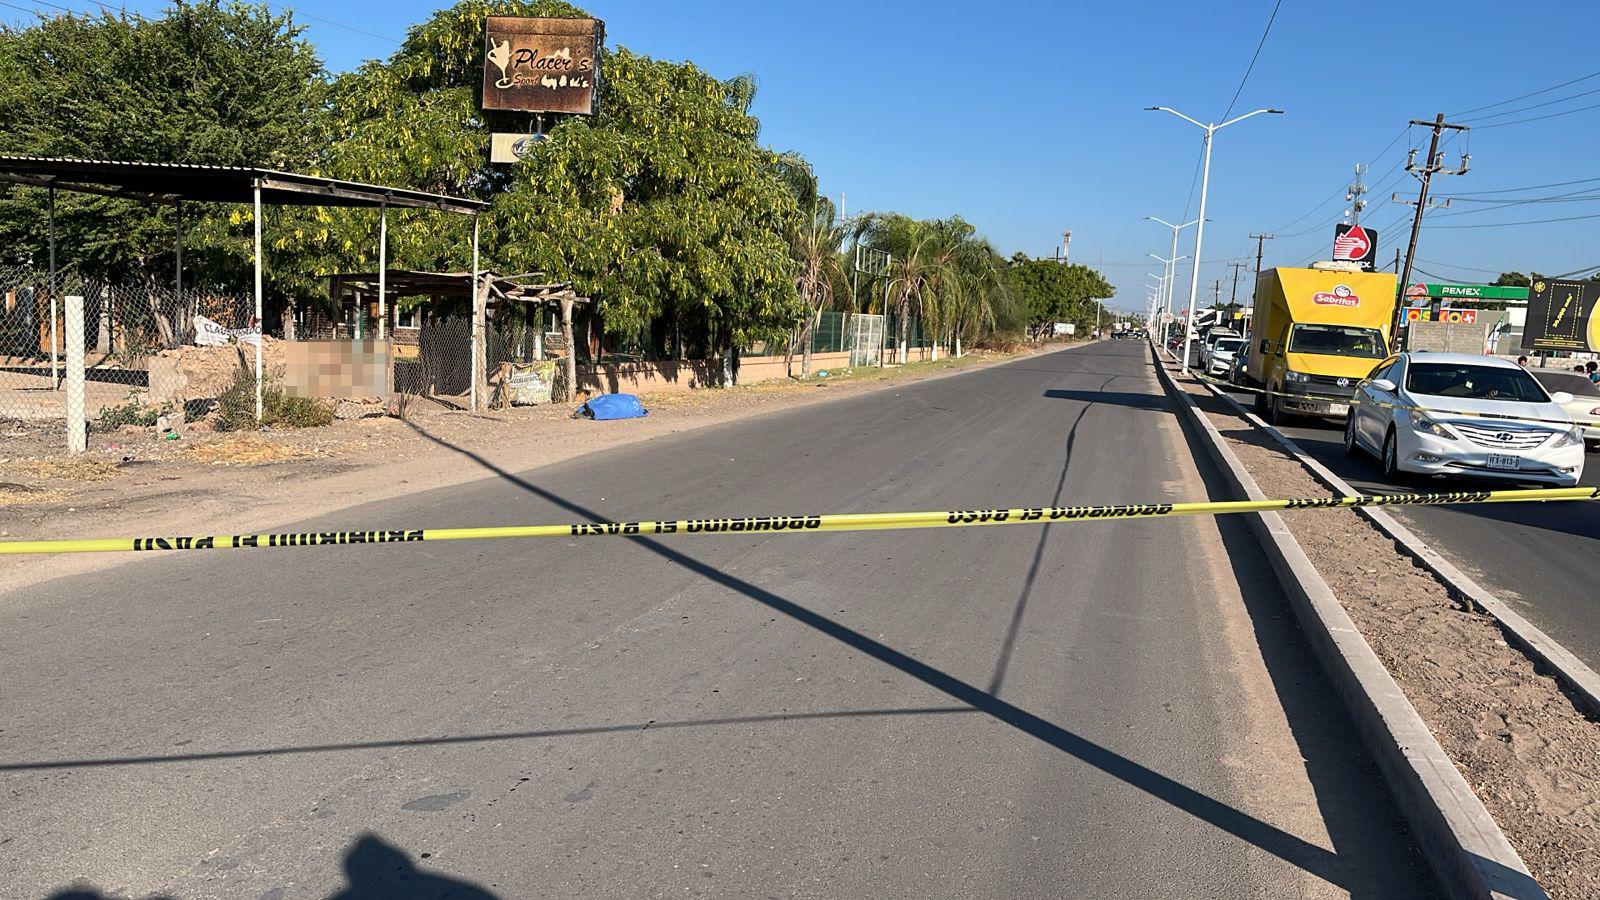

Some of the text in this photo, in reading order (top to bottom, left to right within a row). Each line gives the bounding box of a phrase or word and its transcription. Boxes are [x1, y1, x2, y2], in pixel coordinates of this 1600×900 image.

[1442, 286, 1480, 296] PEMEX
[1316, 294, 1356, 306] Sabritas
[204, 323, 262, 336] CLAUSURADO
